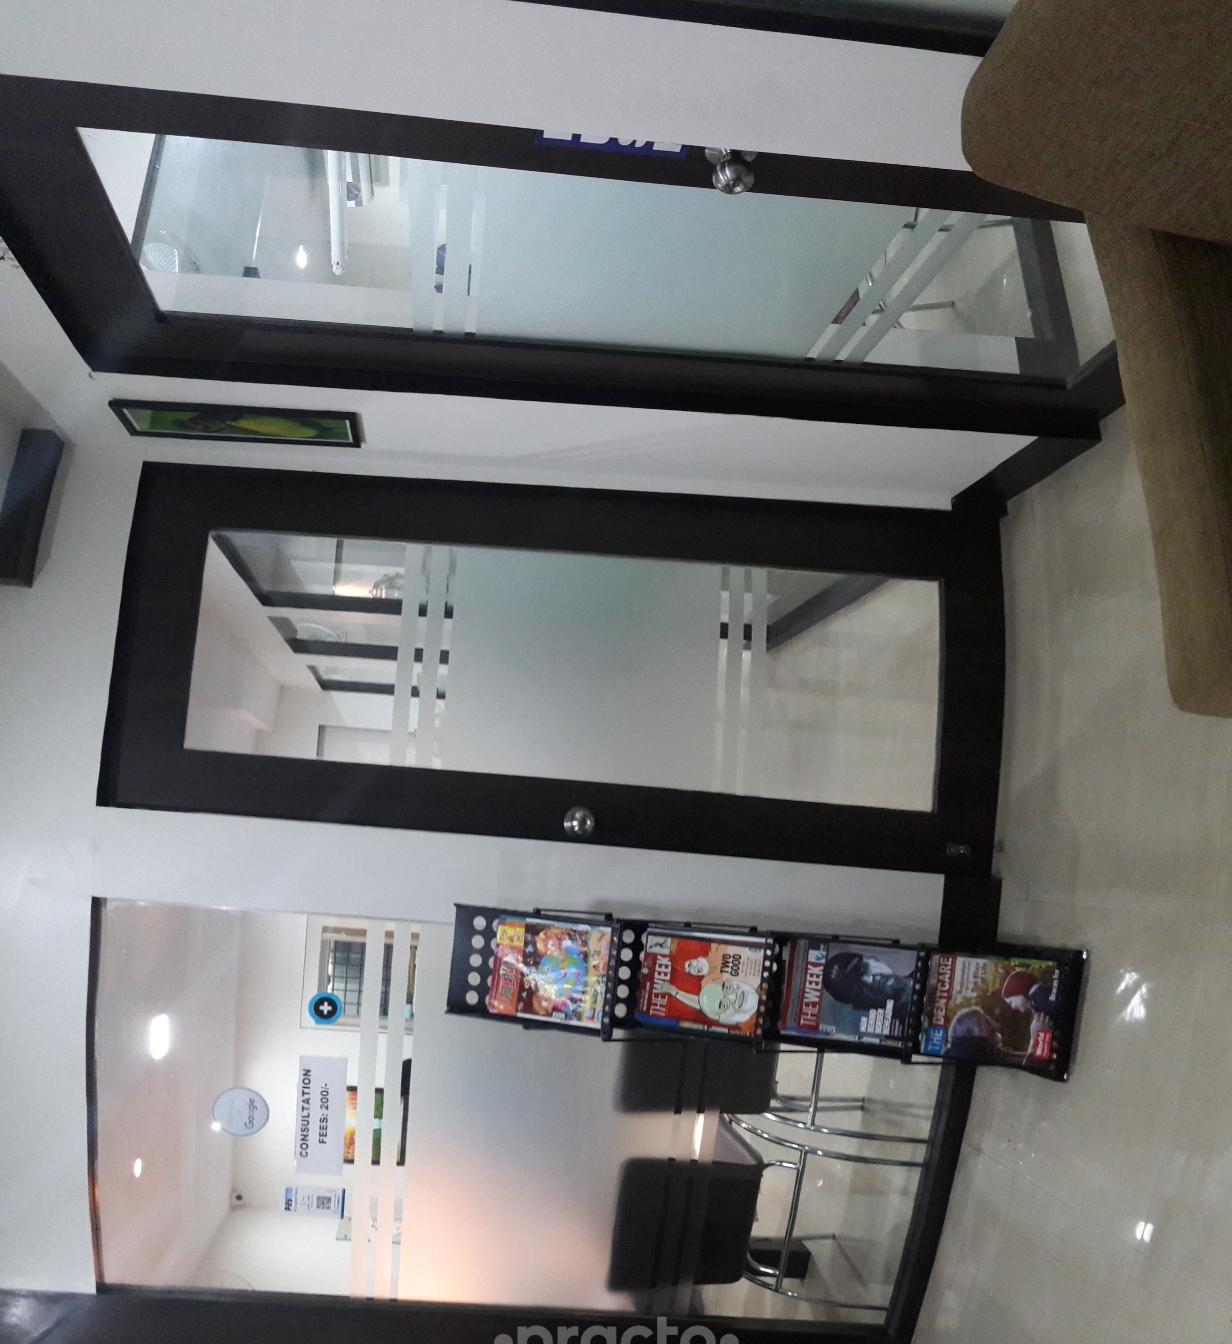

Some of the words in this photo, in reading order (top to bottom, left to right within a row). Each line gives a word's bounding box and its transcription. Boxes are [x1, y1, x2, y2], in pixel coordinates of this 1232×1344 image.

[720, 954, 731, 974] TWO
[730, 954, 742, 976] GOOD
[804, 964, 824, 1002] WEEK
[933, 957, 952, 1025] DENTCARE
[650, 994, 668, 1016] THE
[800, 1002, 818, 1026] THE
[928, 1028, 943, 1051] THE
[320, 1082, 330, 1110] 200/-
[244, 1097, 258, 1128] Google
[300, 1068, 312, 1158] CONSULTATION
[318, 1114, 328, 1144] FEES:
